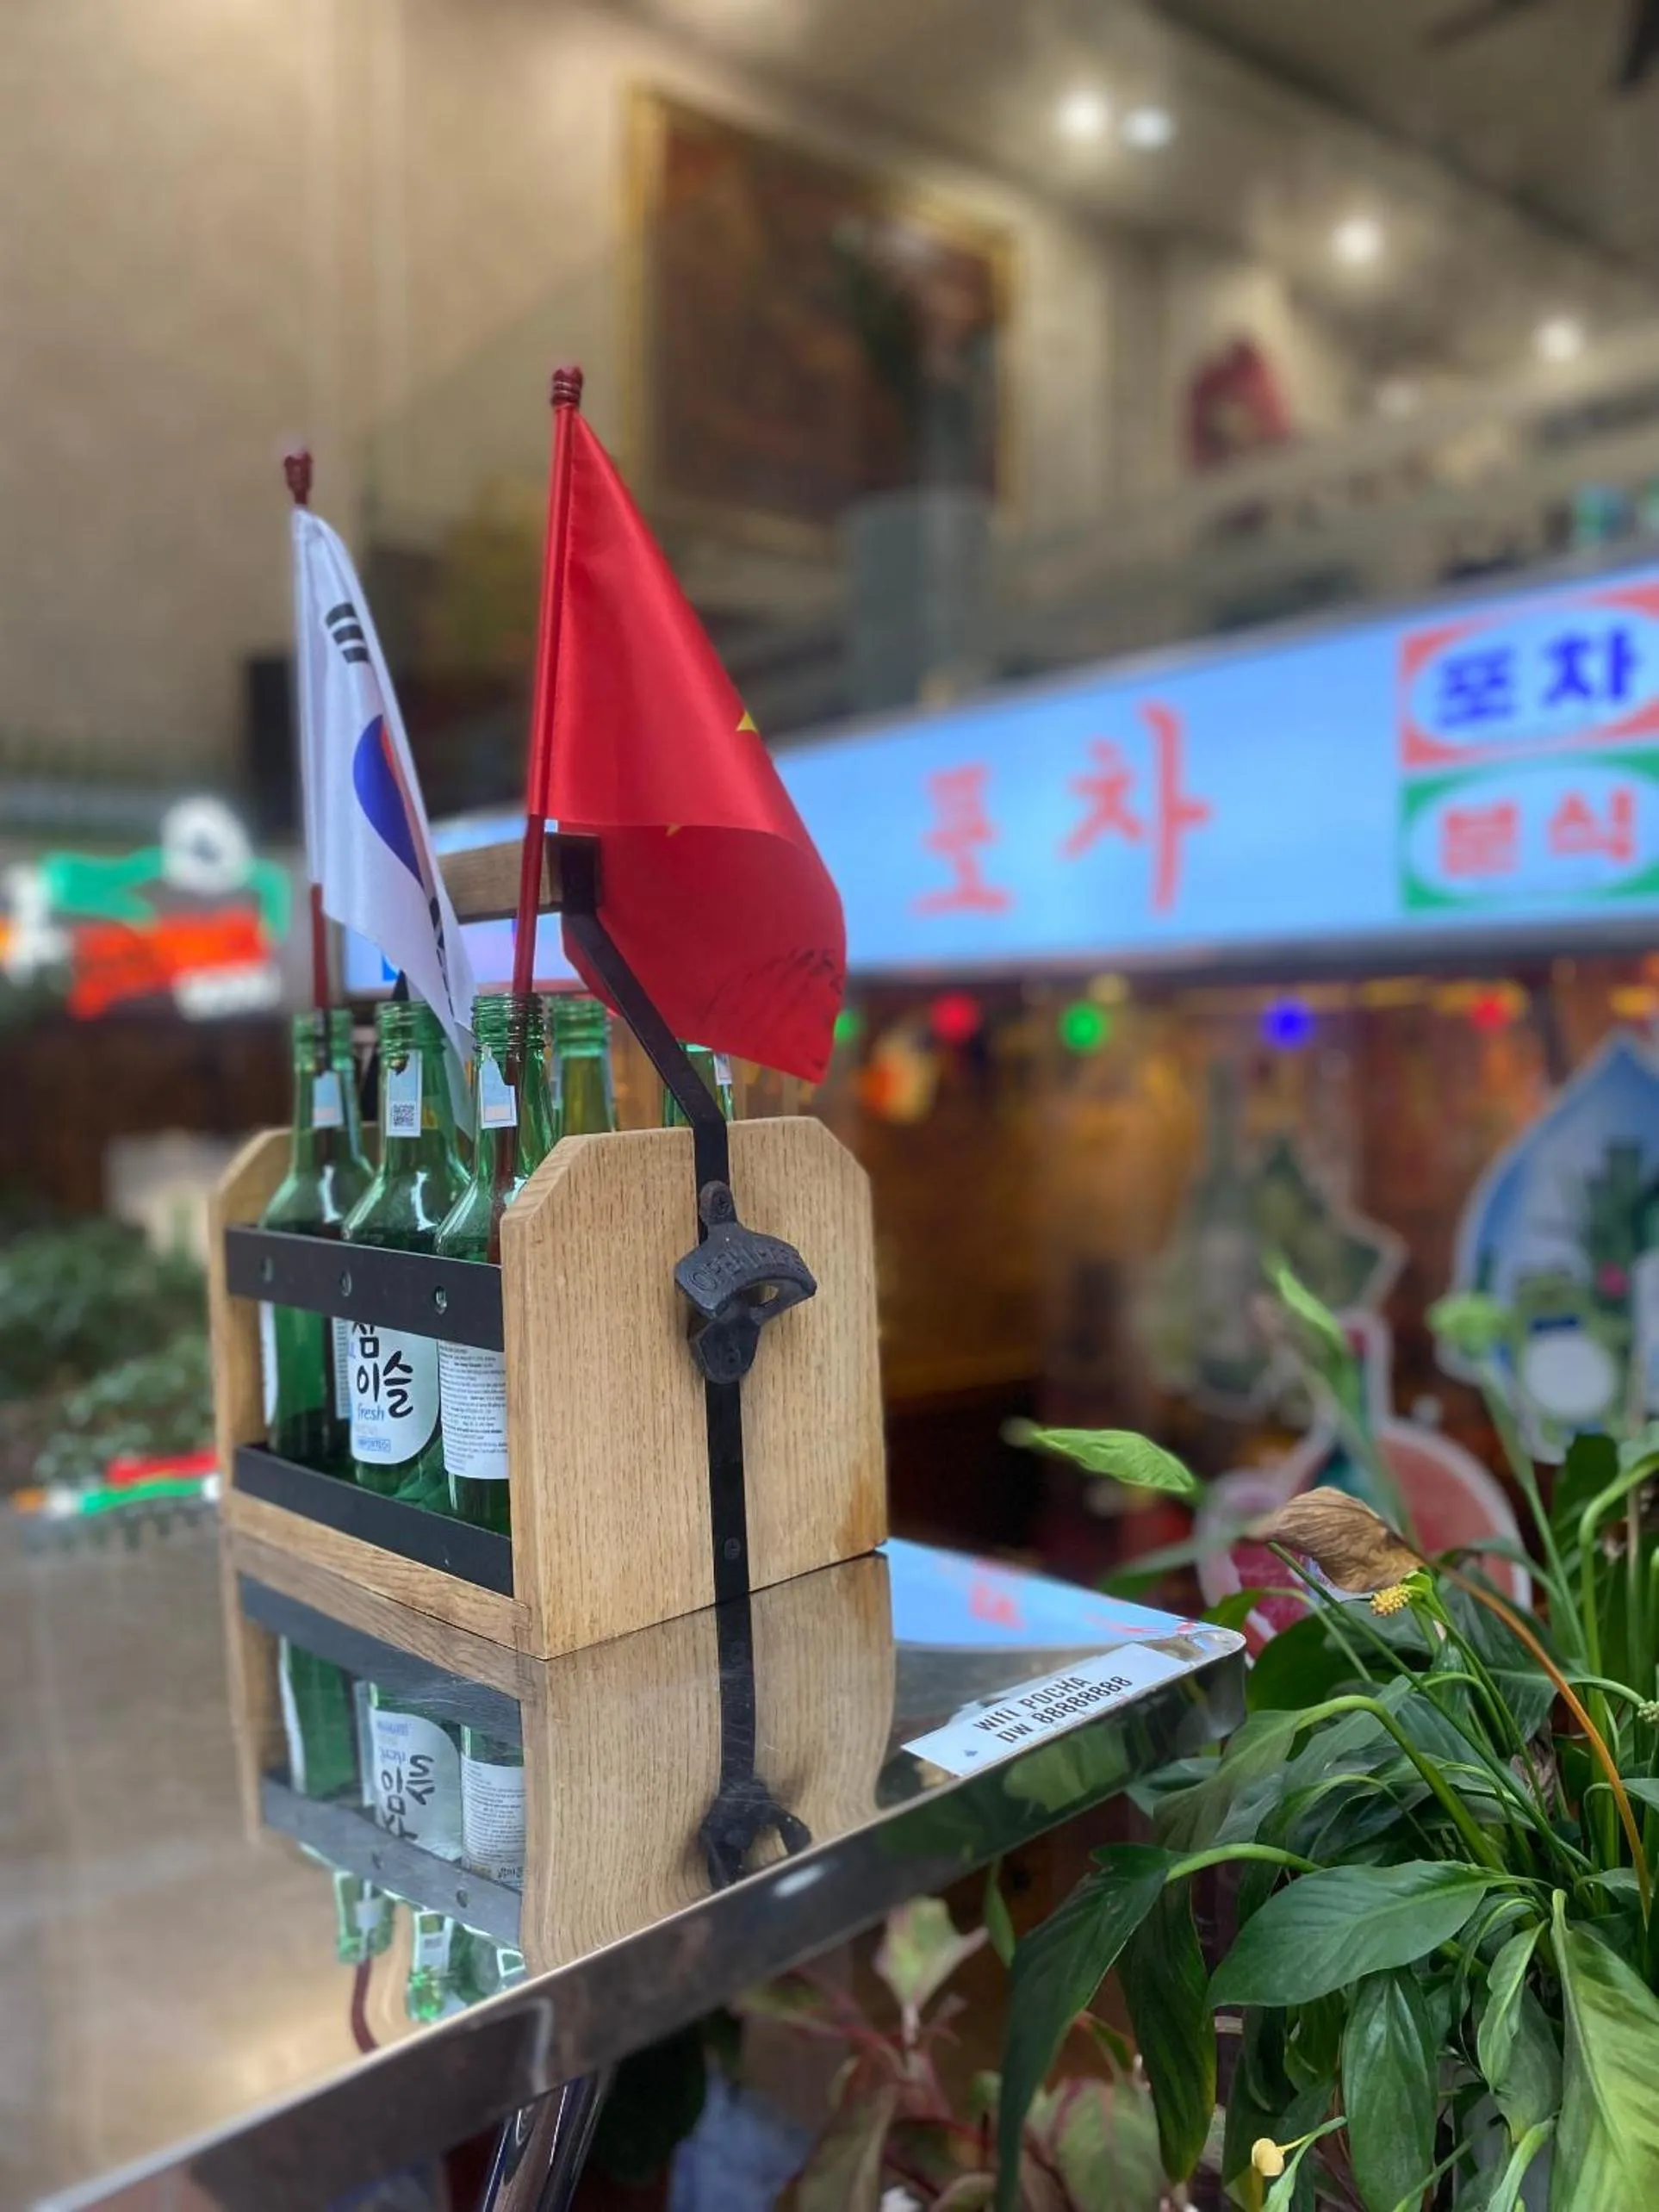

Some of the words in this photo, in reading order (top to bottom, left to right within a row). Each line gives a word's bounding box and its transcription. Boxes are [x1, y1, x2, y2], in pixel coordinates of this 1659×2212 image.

[1438, 628, 1642, 728] 포차
[915, 700, 1210, 915] 포차
[357, 1402, 384, 1421] fresh
[1019, 1677, 1091, 1710] POCHA
[1031, 1676, 1133, 1724] 88888888
